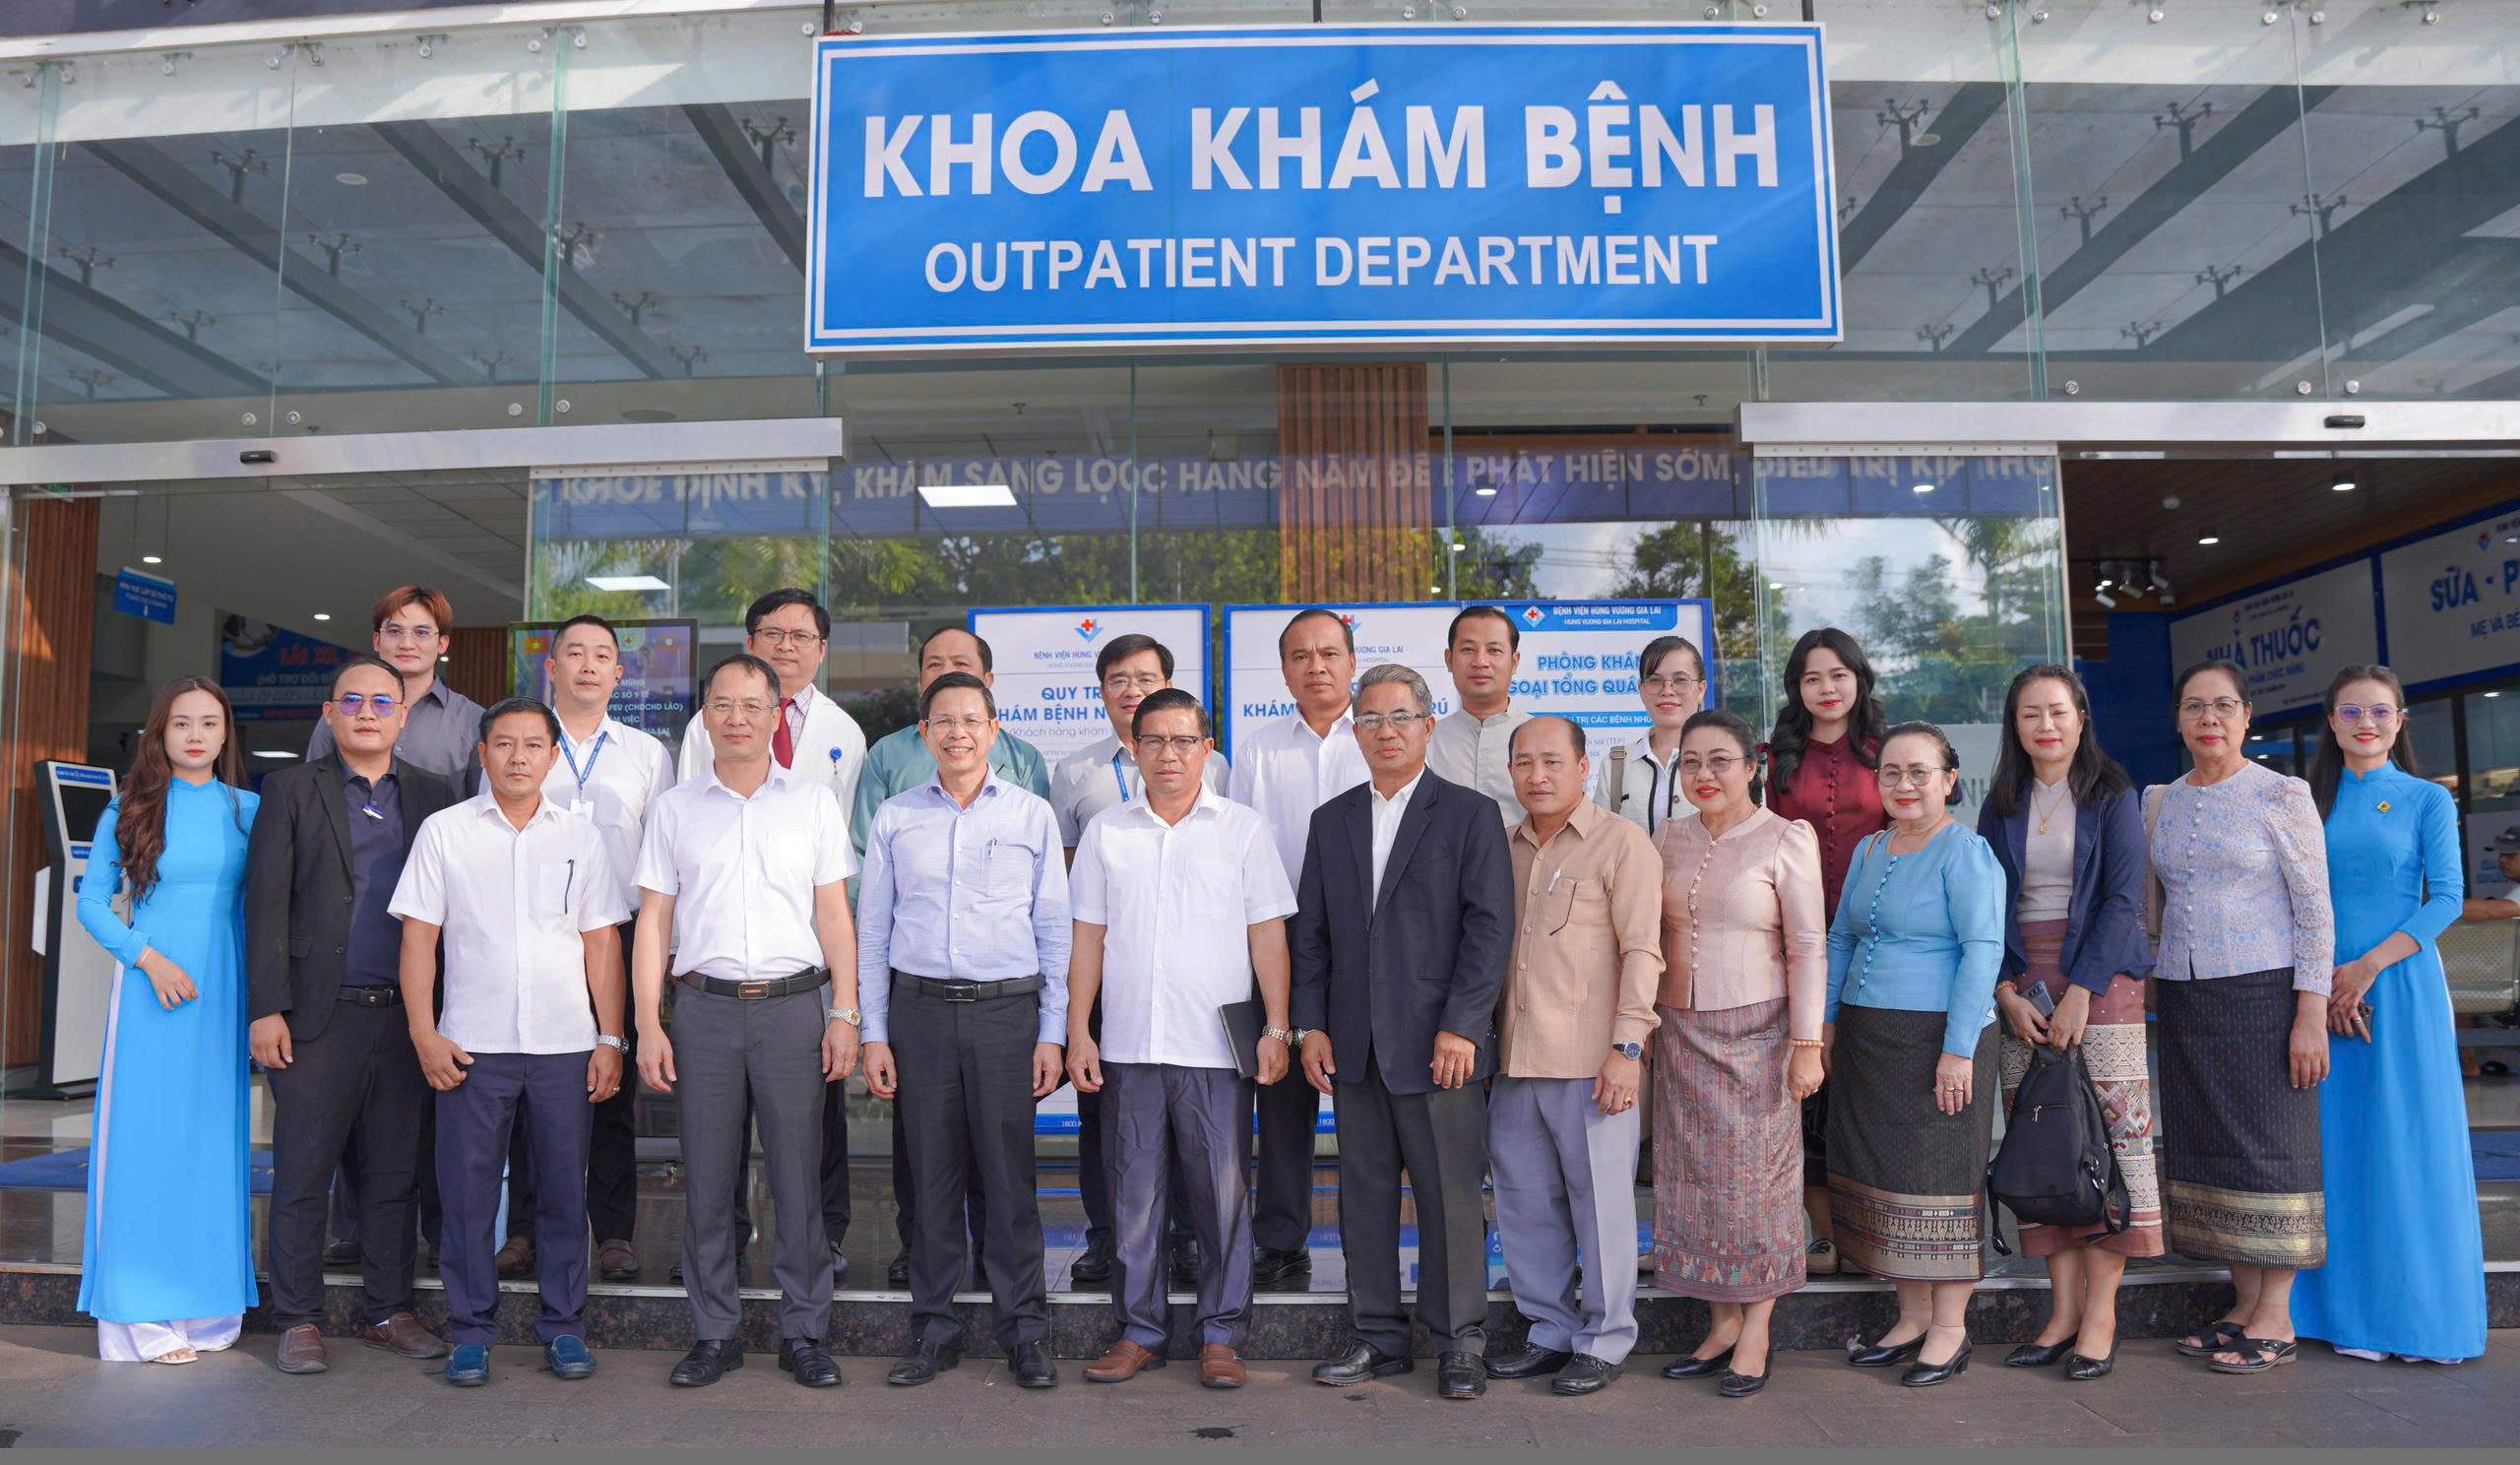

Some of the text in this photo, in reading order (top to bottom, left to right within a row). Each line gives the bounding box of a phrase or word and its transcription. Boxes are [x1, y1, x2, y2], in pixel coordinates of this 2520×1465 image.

[863, 79, 1779, 214] KHOA KHÁM BỆNH
[924, 235, 1718, 293] OUTPATIENT DEPARTMENT
[1467, 451, 1554, 485] PHÁT
[1565, 449, 1645, 490] HIỆN
[2430, 565, 2481, 612] SỮA
[1552, 605, 1572, 616] BỆNH
[1573, 605, 1589, 616] VIỆN
[1636, 605, 1649, 615] GIA
[1650, 605, 1662, 615] LAI
[2250, 605, 2323, 666] THUỐC
[1537, 650, 1597, 671] PHÒNG
[1041, 686, 1102, 701] QUY TR
[1508, 671, 1641, 700] GOẠI TỔNG QUÁ
[998, 703, 1105, 725] HÁM BỆNH N
[1243, 696, 1449, 718] KHÁM RÚ
